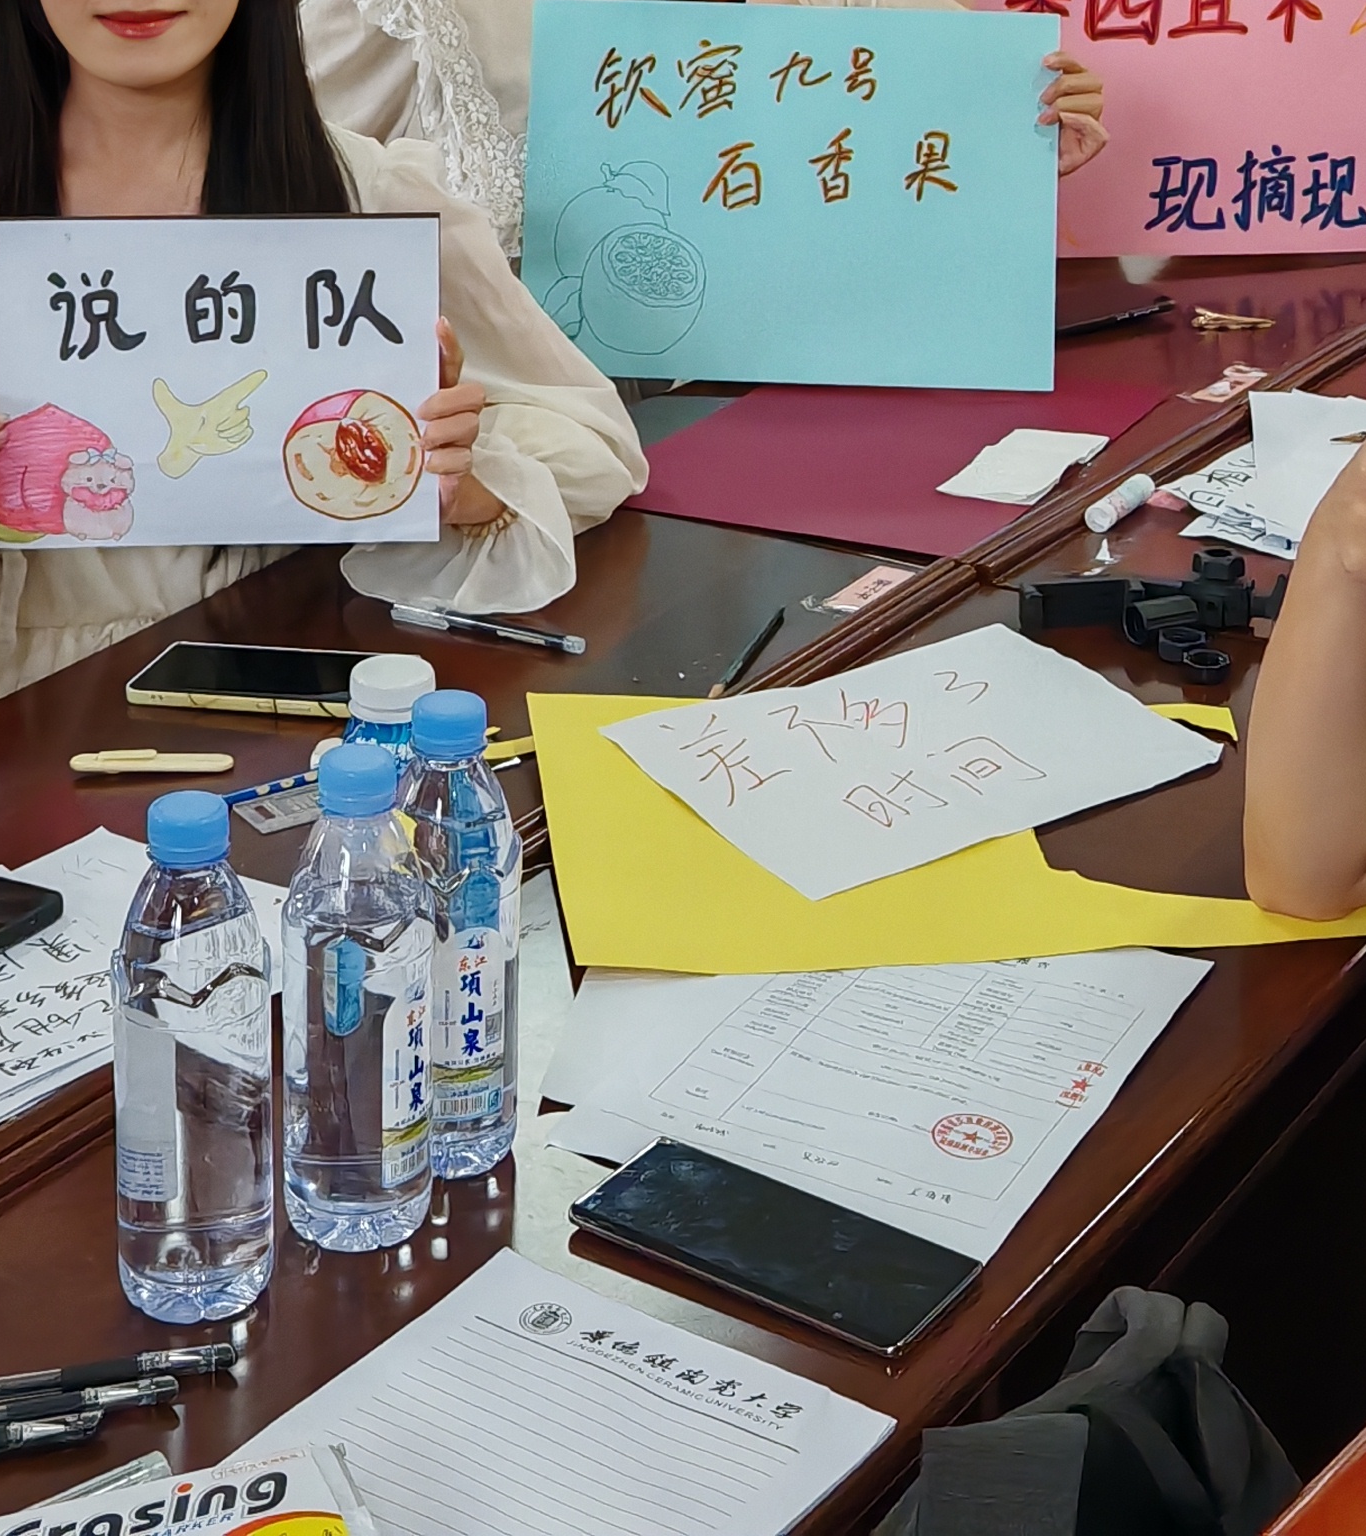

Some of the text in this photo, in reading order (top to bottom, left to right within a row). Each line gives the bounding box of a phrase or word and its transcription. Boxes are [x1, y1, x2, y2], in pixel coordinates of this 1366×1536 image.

[47, 269, 404, 361] 说的队
[842, 736, 1047, 828] 时间
[645, 1372, 705, 1402] CERAMIC
[704, 1397, 785, 1432] UNIVERSITY
